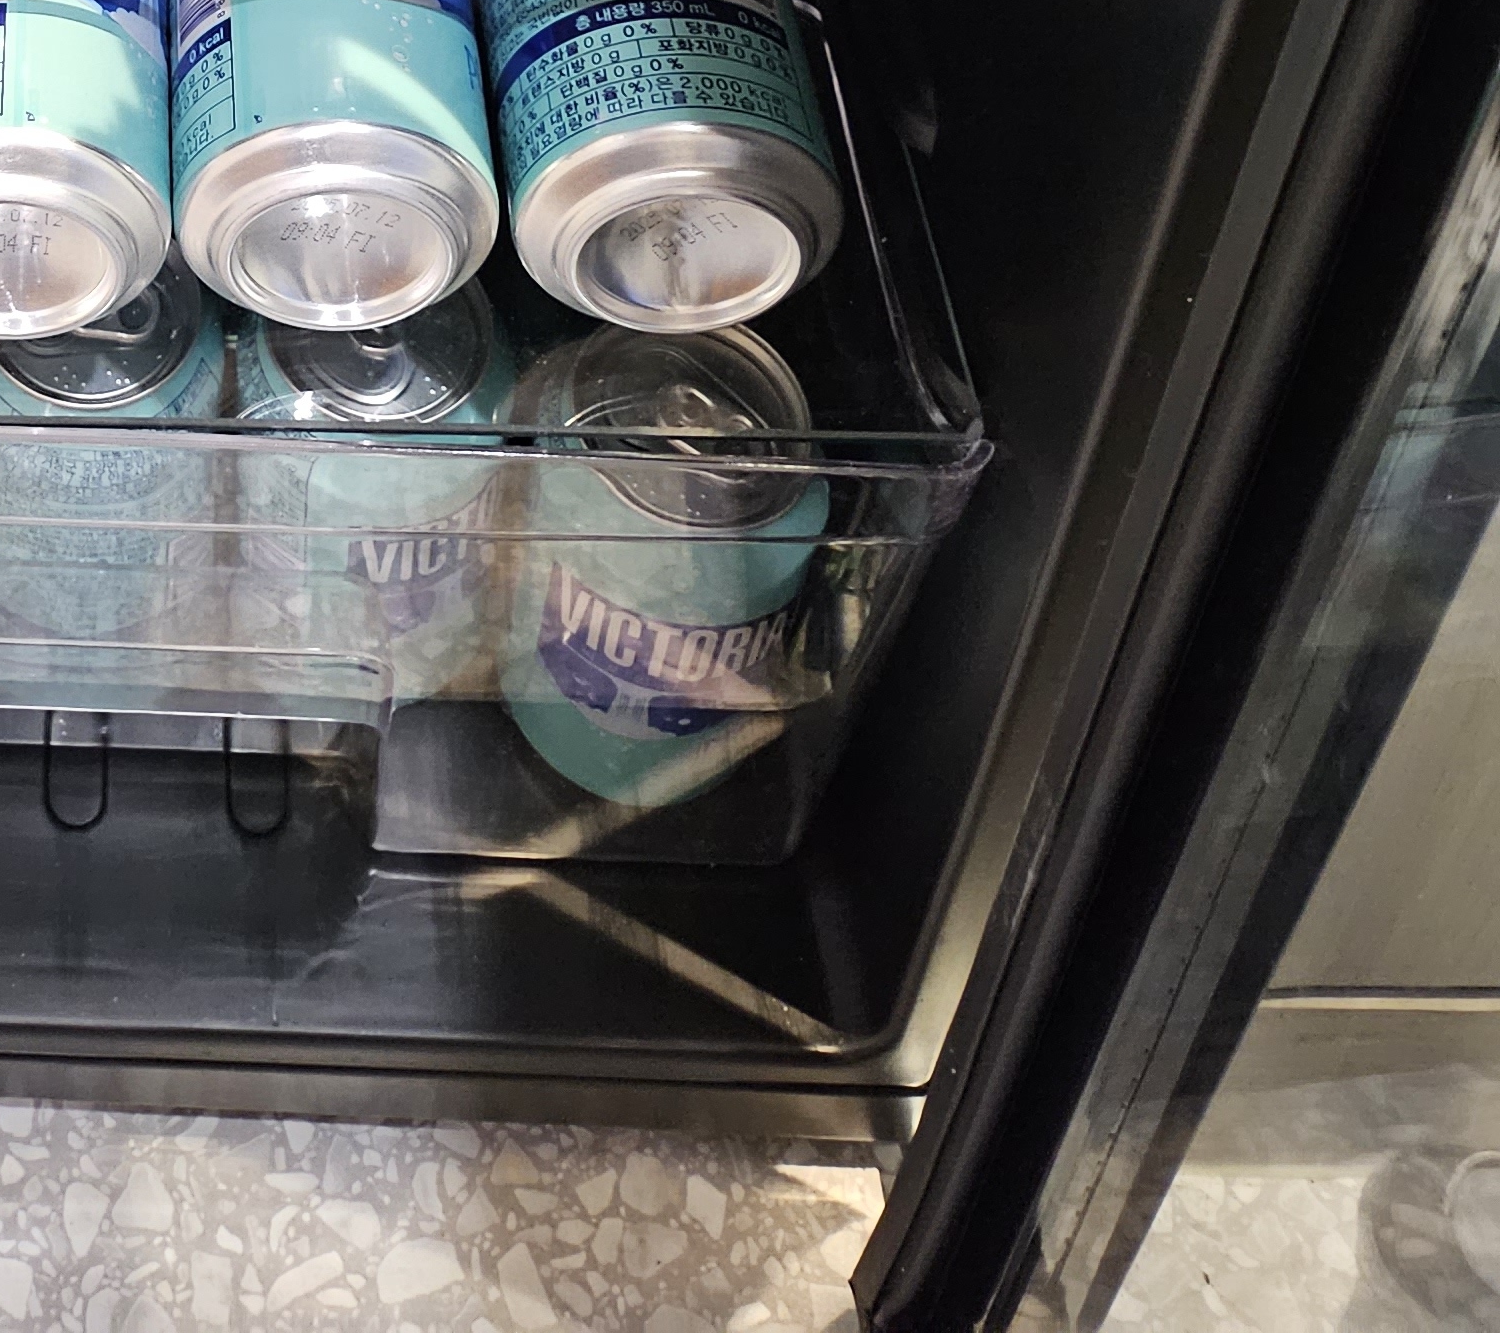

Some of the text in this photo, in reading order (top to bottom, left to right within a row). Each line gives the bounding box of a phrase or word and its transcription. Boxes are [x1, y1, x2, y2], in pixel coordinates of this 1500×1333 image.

[594, 0, 716, 23] 내용량 350 mL
[199, 27, 225, 54] kcal
[606, 97, 644, 115] 따라
[560, 562, 784, 682] VICTORIA
